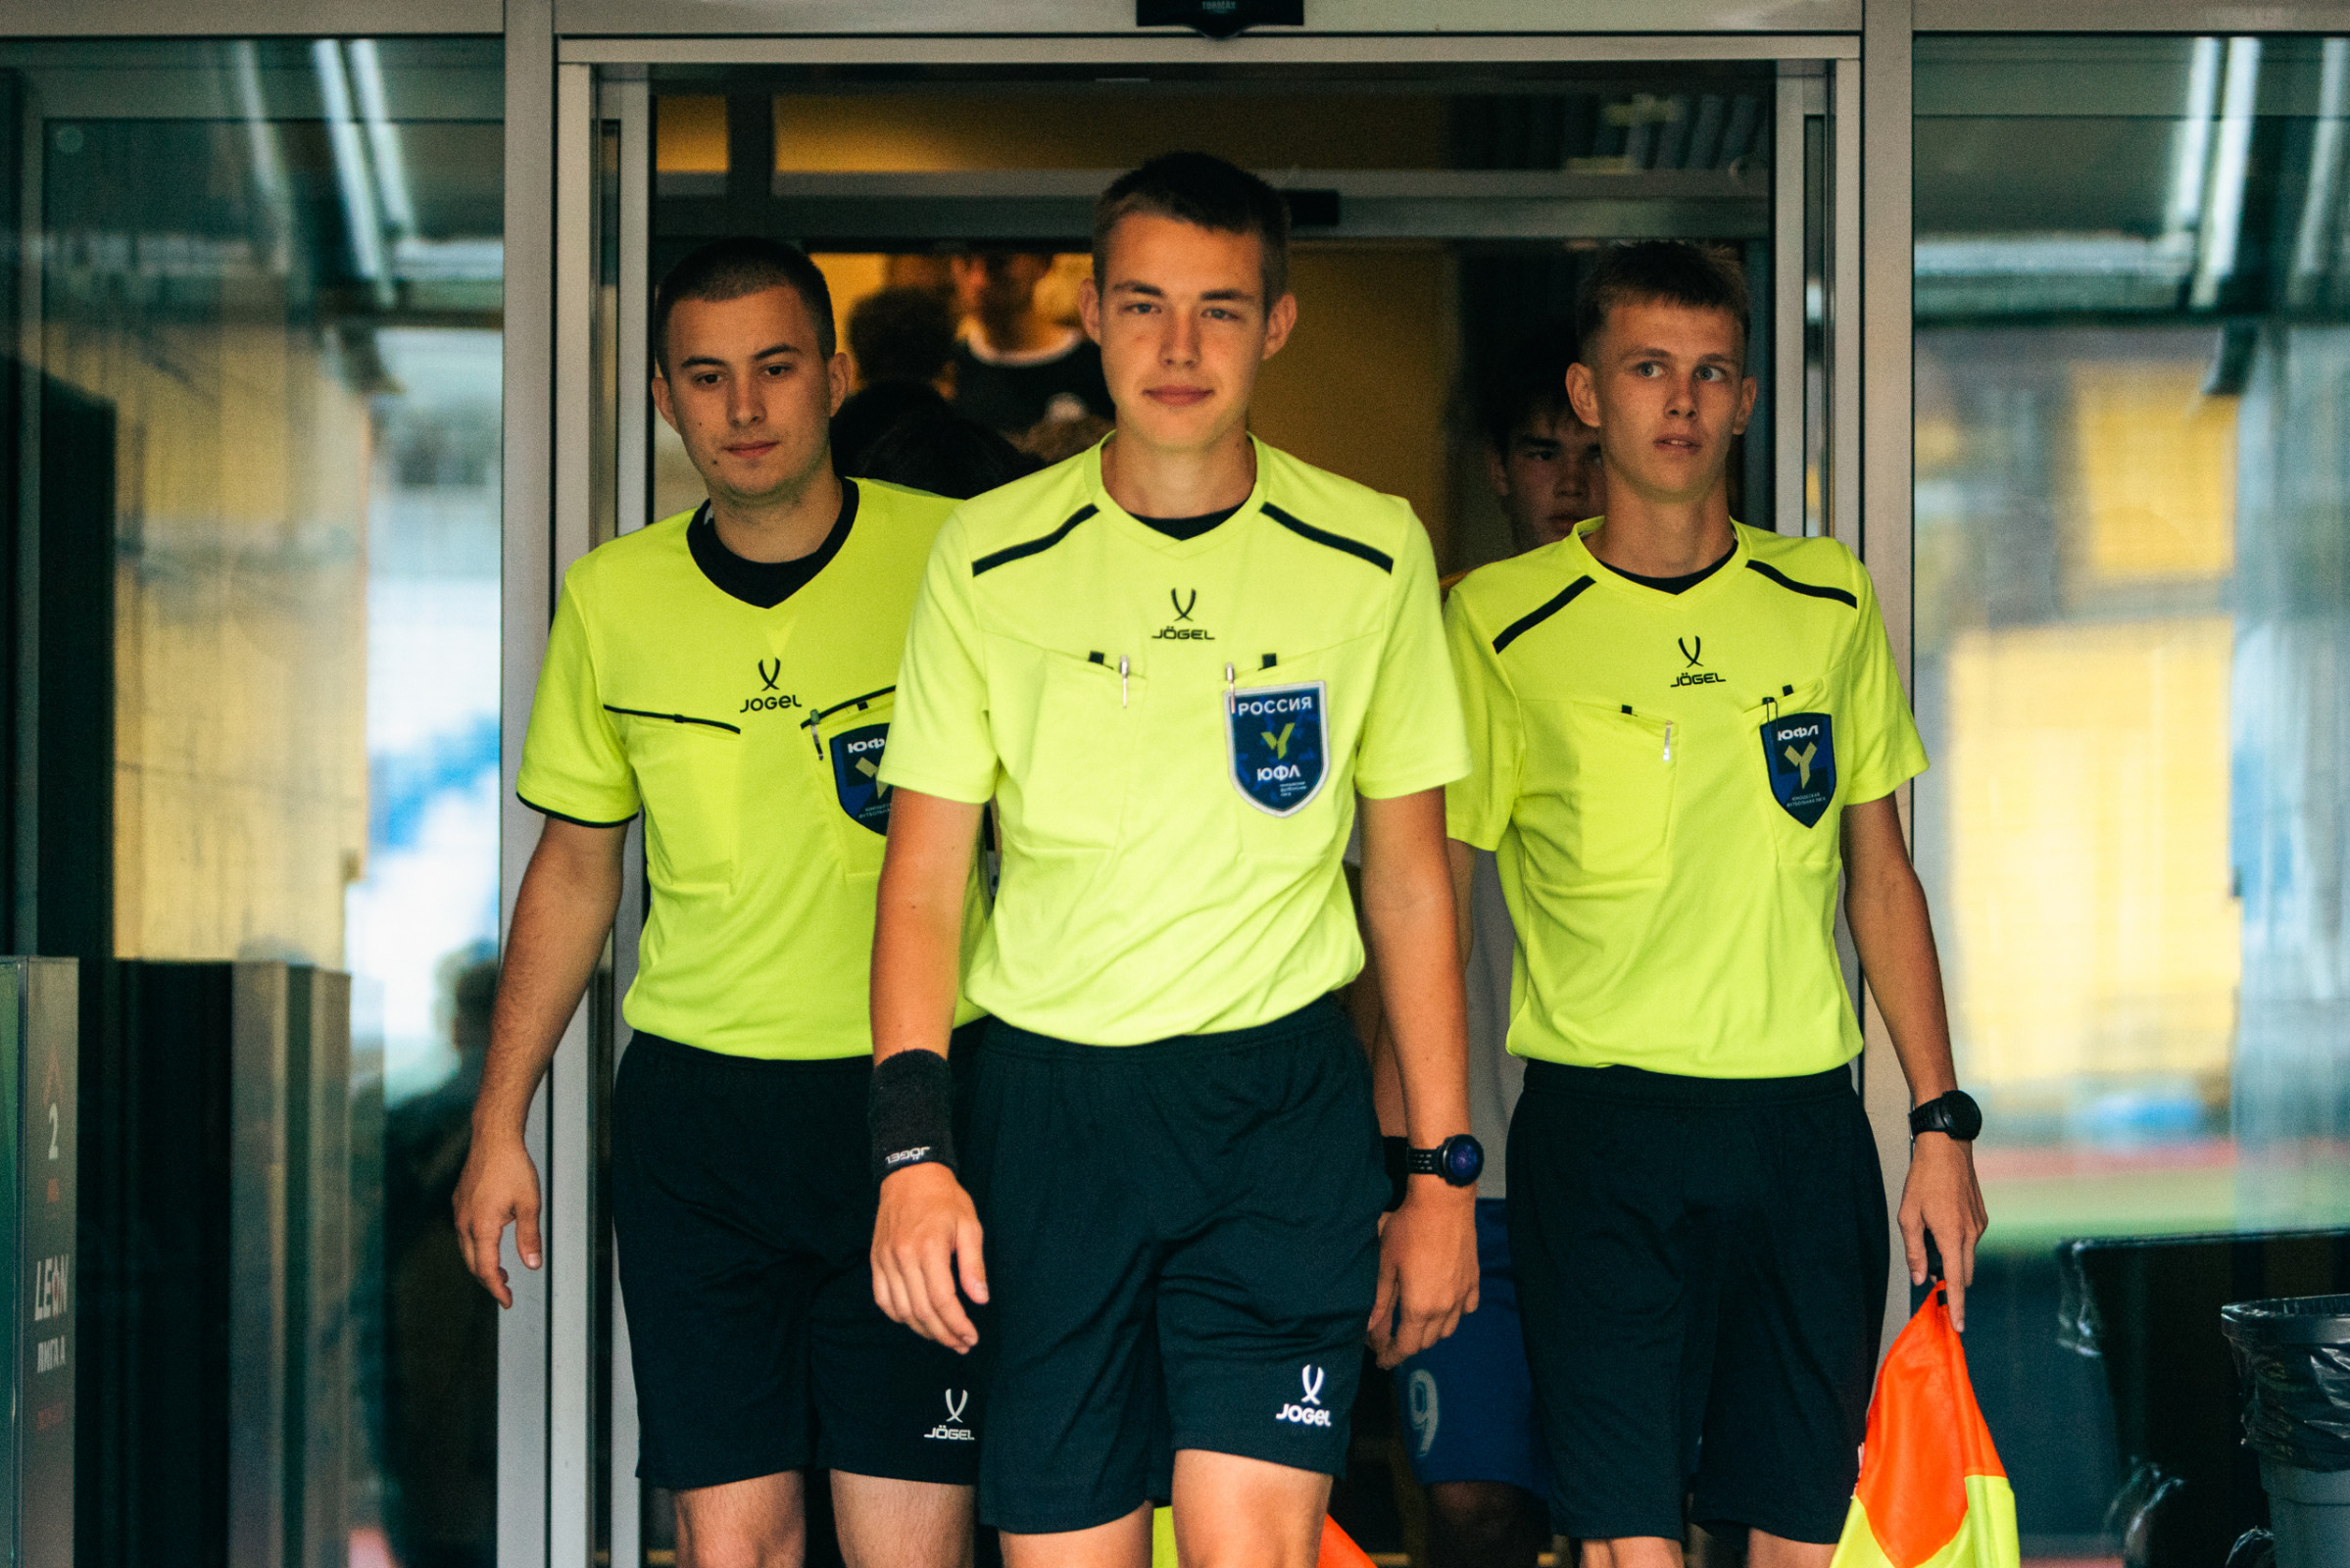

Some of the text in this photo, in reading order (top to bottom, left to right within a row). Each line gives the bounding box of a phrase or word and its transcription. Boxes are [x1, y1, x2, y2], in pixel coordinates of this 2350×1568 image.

[1151, 625, 1215, 640] JÖGEL
[1670, 672, 1726, 688] JÖGEL
[1238, 696, 1312, 716] РОССИЯ
[1777, 725, 1819, 741] ЮФЛ
[848, 738, 886, 754] ЮФ
[1256, 764, 1301, 782] ЮФЛ
[48, 1102, 59, 1160] 2
[885, 1146, 931, 1164] JÖGEL
[34, 1253, 70, 1321] LEON
[1408, 1369, 1439, 1457] 9
[923, 1424, 975, 1441] JÖGEL
